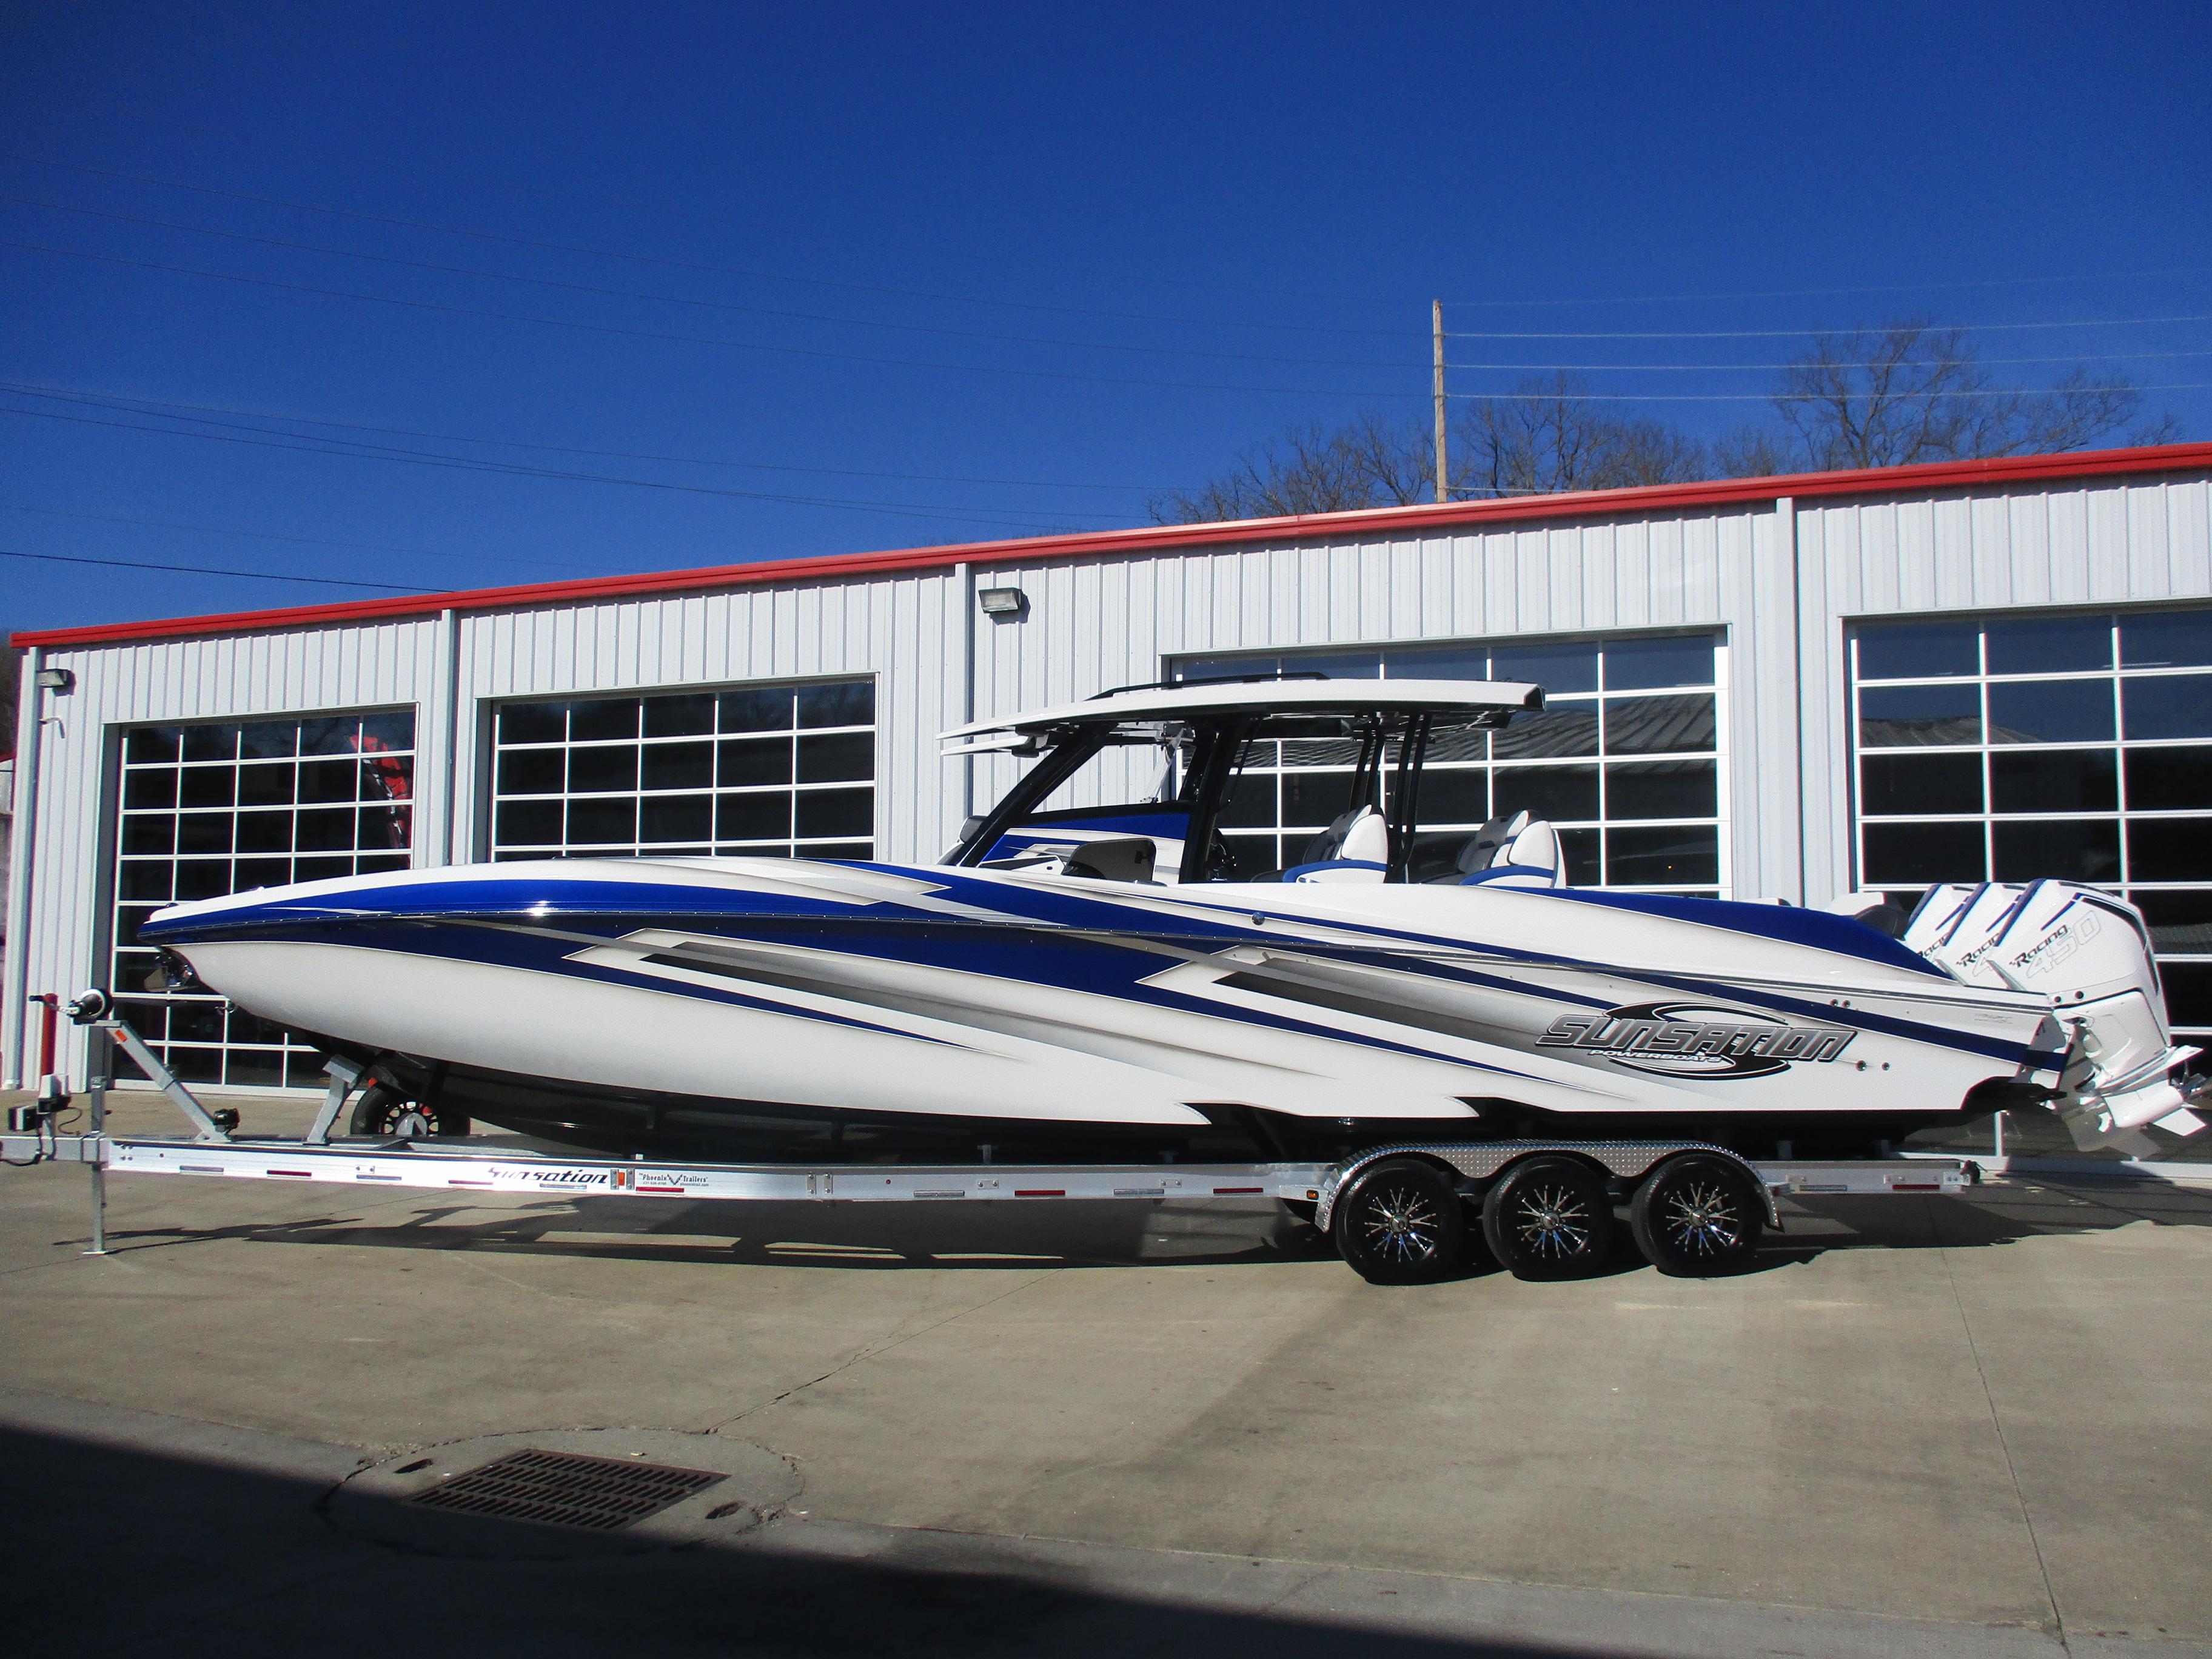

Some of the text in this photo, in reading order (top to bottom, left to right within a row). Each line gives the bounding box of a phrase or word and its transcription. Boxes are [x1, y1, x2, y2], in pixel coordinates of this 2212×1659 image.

[2013, 925, 2069, 968] Racing
[2026, 910, 2101, 978] 450
[1535, 1014, 1858, 1062] SUNSATION
[1588, 1049, 1723, 1062] POWERBOATS
[488, 1167, 609, 1184] Sunsation
